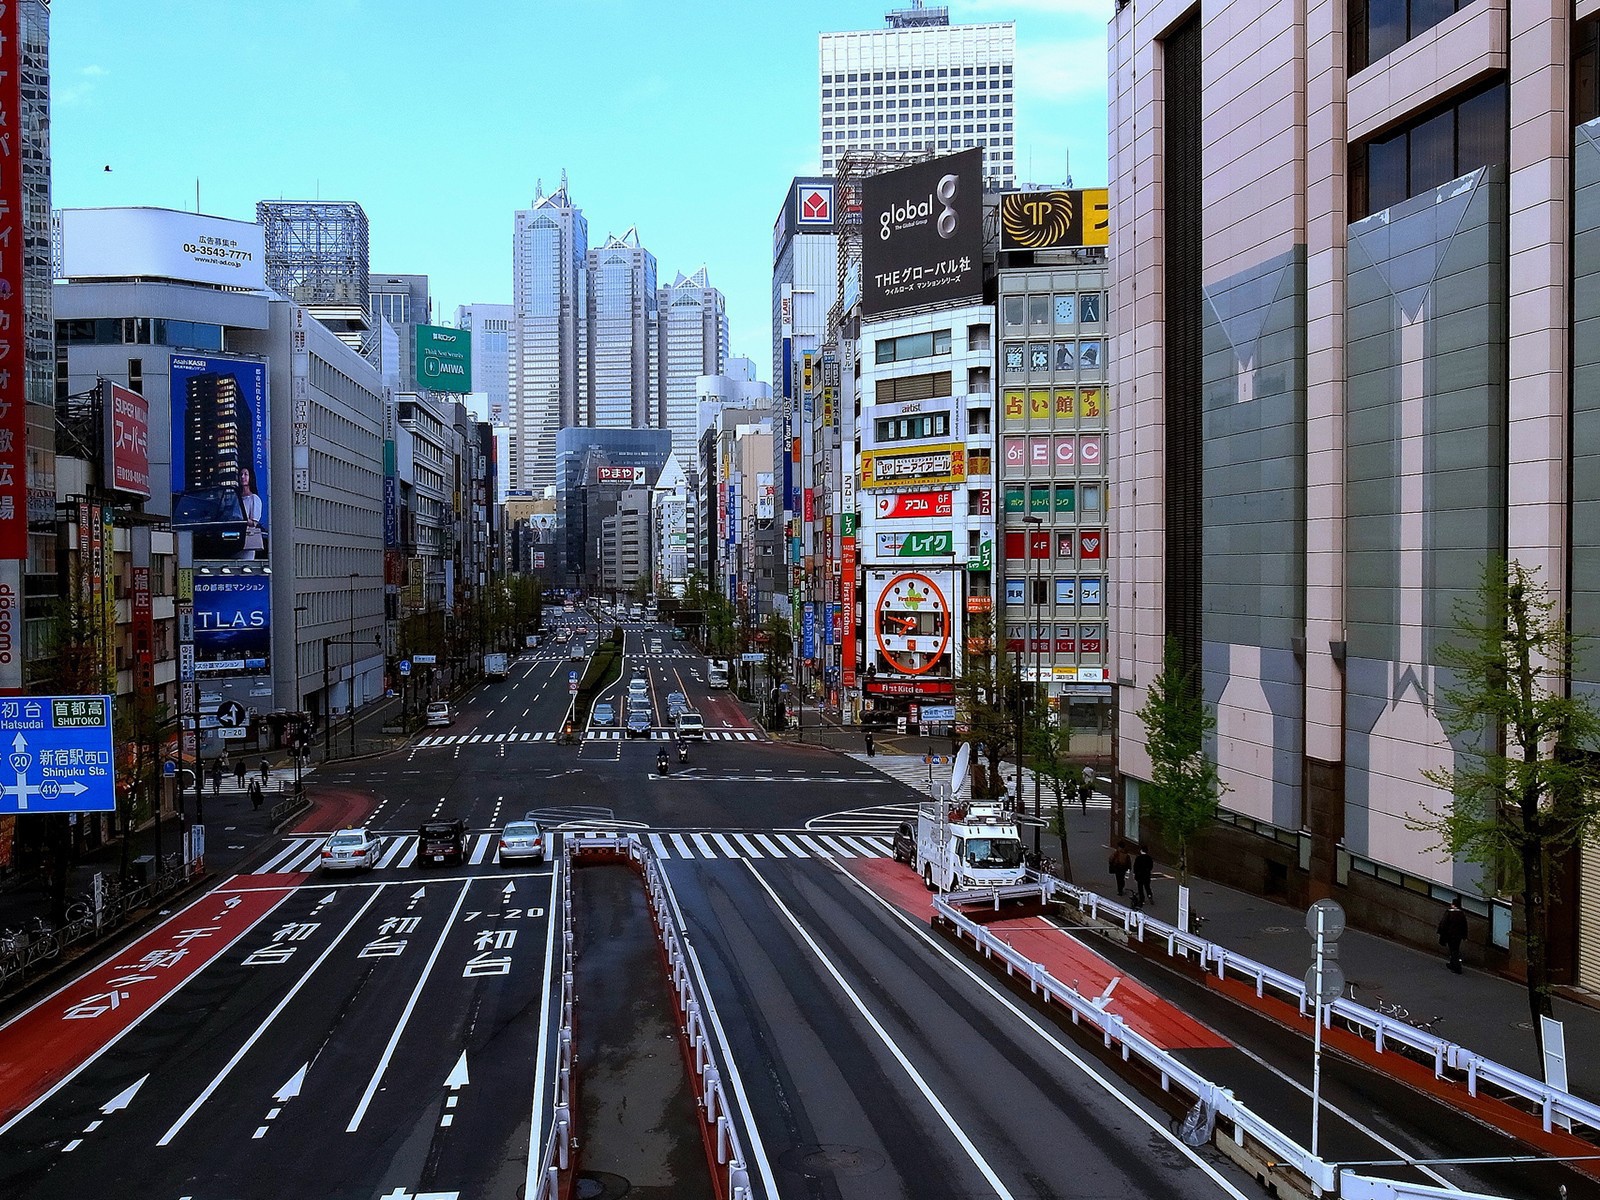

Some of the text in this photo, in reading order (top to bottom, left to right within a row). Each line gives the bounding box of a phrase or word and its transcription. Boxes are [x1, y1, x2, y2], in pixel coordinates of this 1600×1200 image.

[880, 194, 932, 240] global
[184, 244, 252, 261] 03-3543-7771
[875, 256, 971, 288] THEグローバル社
[1007, 352, 1047, 367] 整体
[440, 363, 464, 375] MIWA
[1006, 396, 1073, 415] 占い館
[1008, 443, 1098, 460] 6F ECC
[601, 469, 632, 478] やまや
[905, 499, 928, 510] アコム
[938, 494, 949, 503] 6F
[912, 535, 947, 551] レイク
[134, 574, 149, 607] 指圧
[0, 584, 15, 664] docomo
[194, 611, 264, 628] TLAS
[1010, 627, 1096, 637] パソコン
[1, 701, 42, 719] 初台
[55, 701, 102, 716] 首都高
[0, 720, 44, 730] Hatsudai
[58, 717, 100, 726] SHUTOKO
[14, 756, 28, 767] 20
[39, 748, 109, 766] 新宿駅西口
[42, 767, 107, 778] Shinjuku Sta.
[42, 784, 58, 794] 414
[464, 906, 544, 923] 7-20
[241, 922, 322, 966] 初台
[357, 916, 415, 958] 初台
[462, 929, 518, 978] 初台
